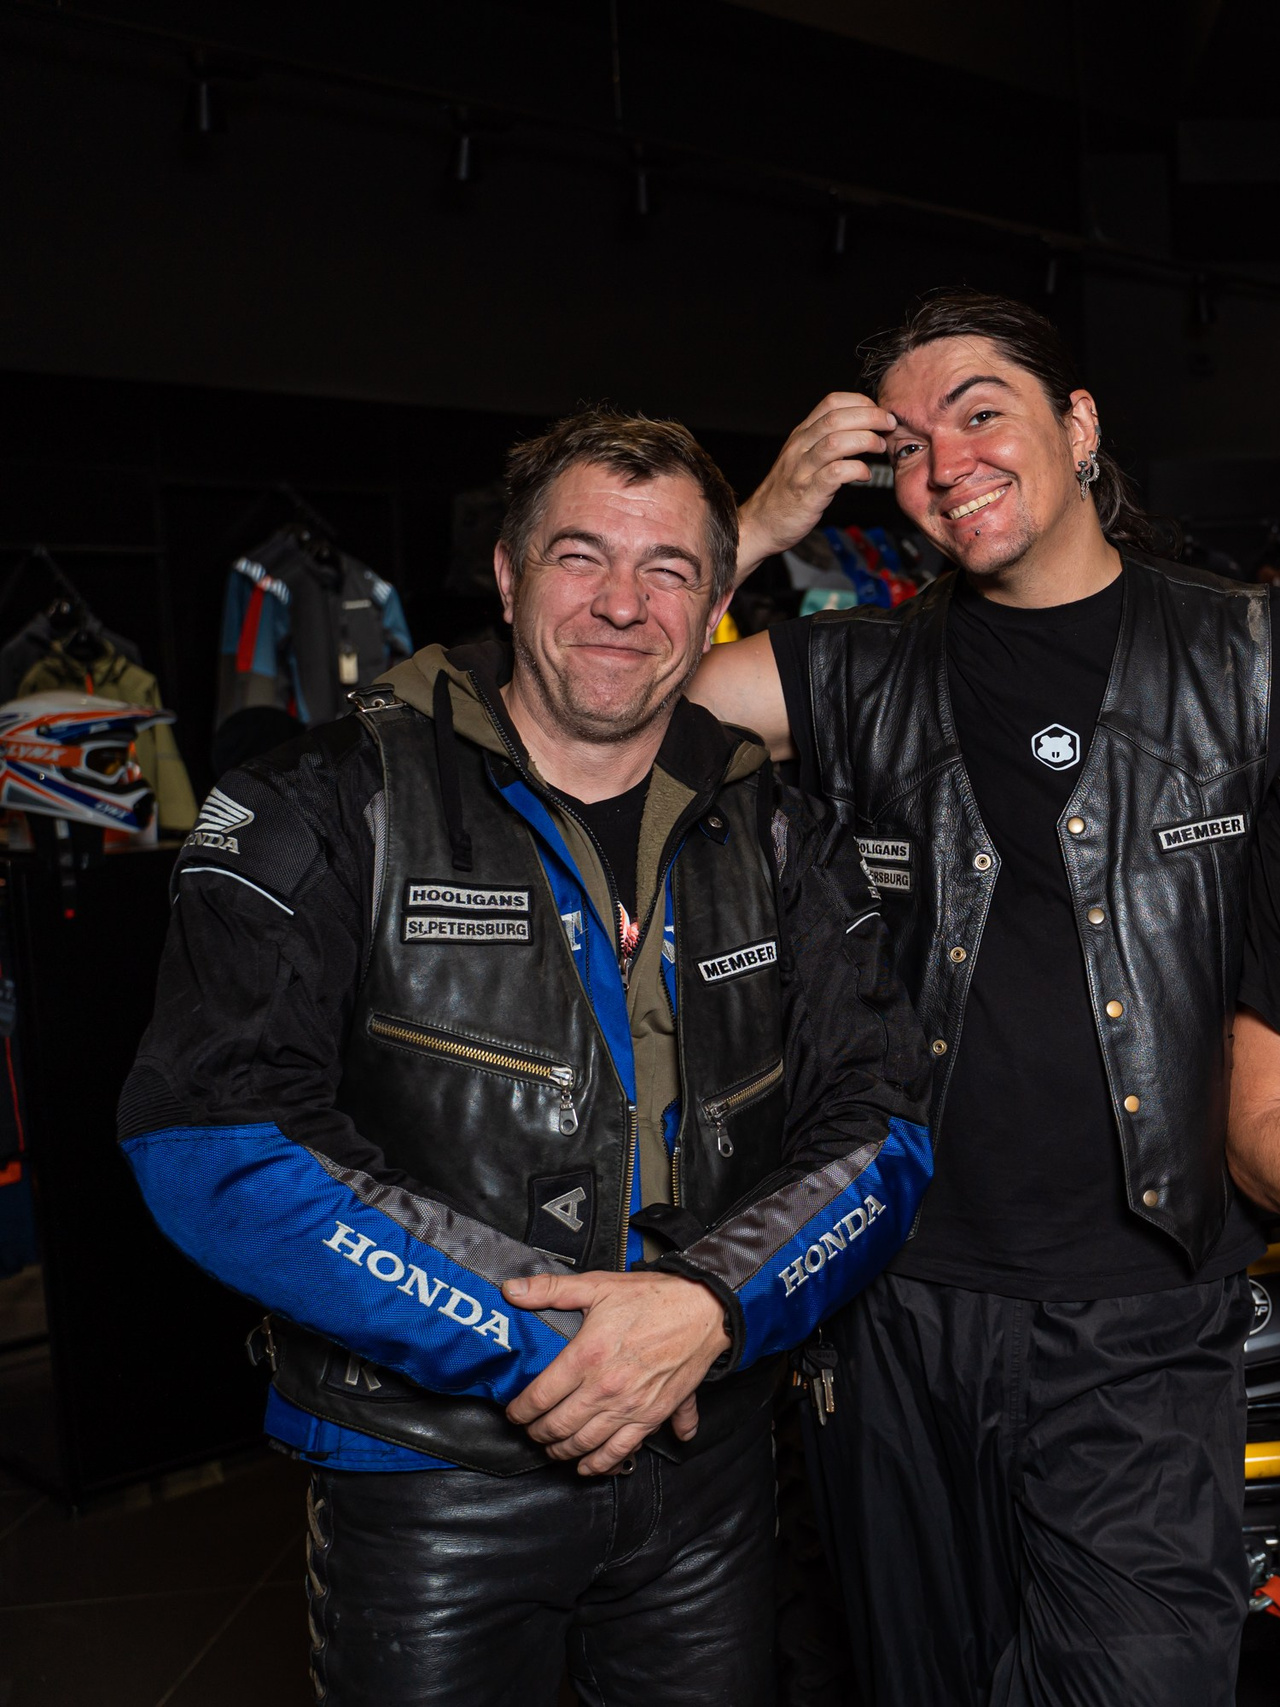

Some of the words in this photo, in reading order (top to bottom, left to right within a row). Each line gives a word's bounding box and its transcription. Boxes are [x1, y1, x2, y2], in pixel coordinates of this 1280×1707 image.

[1163, 818, 1242, 846] MEMBER
[858, 843, 907, 857] OLIGANS
[412, 889, 526, 907] HOOLIGANS
[407, 920, 527, 936] St.PETERSBURG
[703, 945, 776, 979] MEMBER
[778, 1194, 888, 1299] HONDA
[322, 1220, 513, 1353] HONDA
